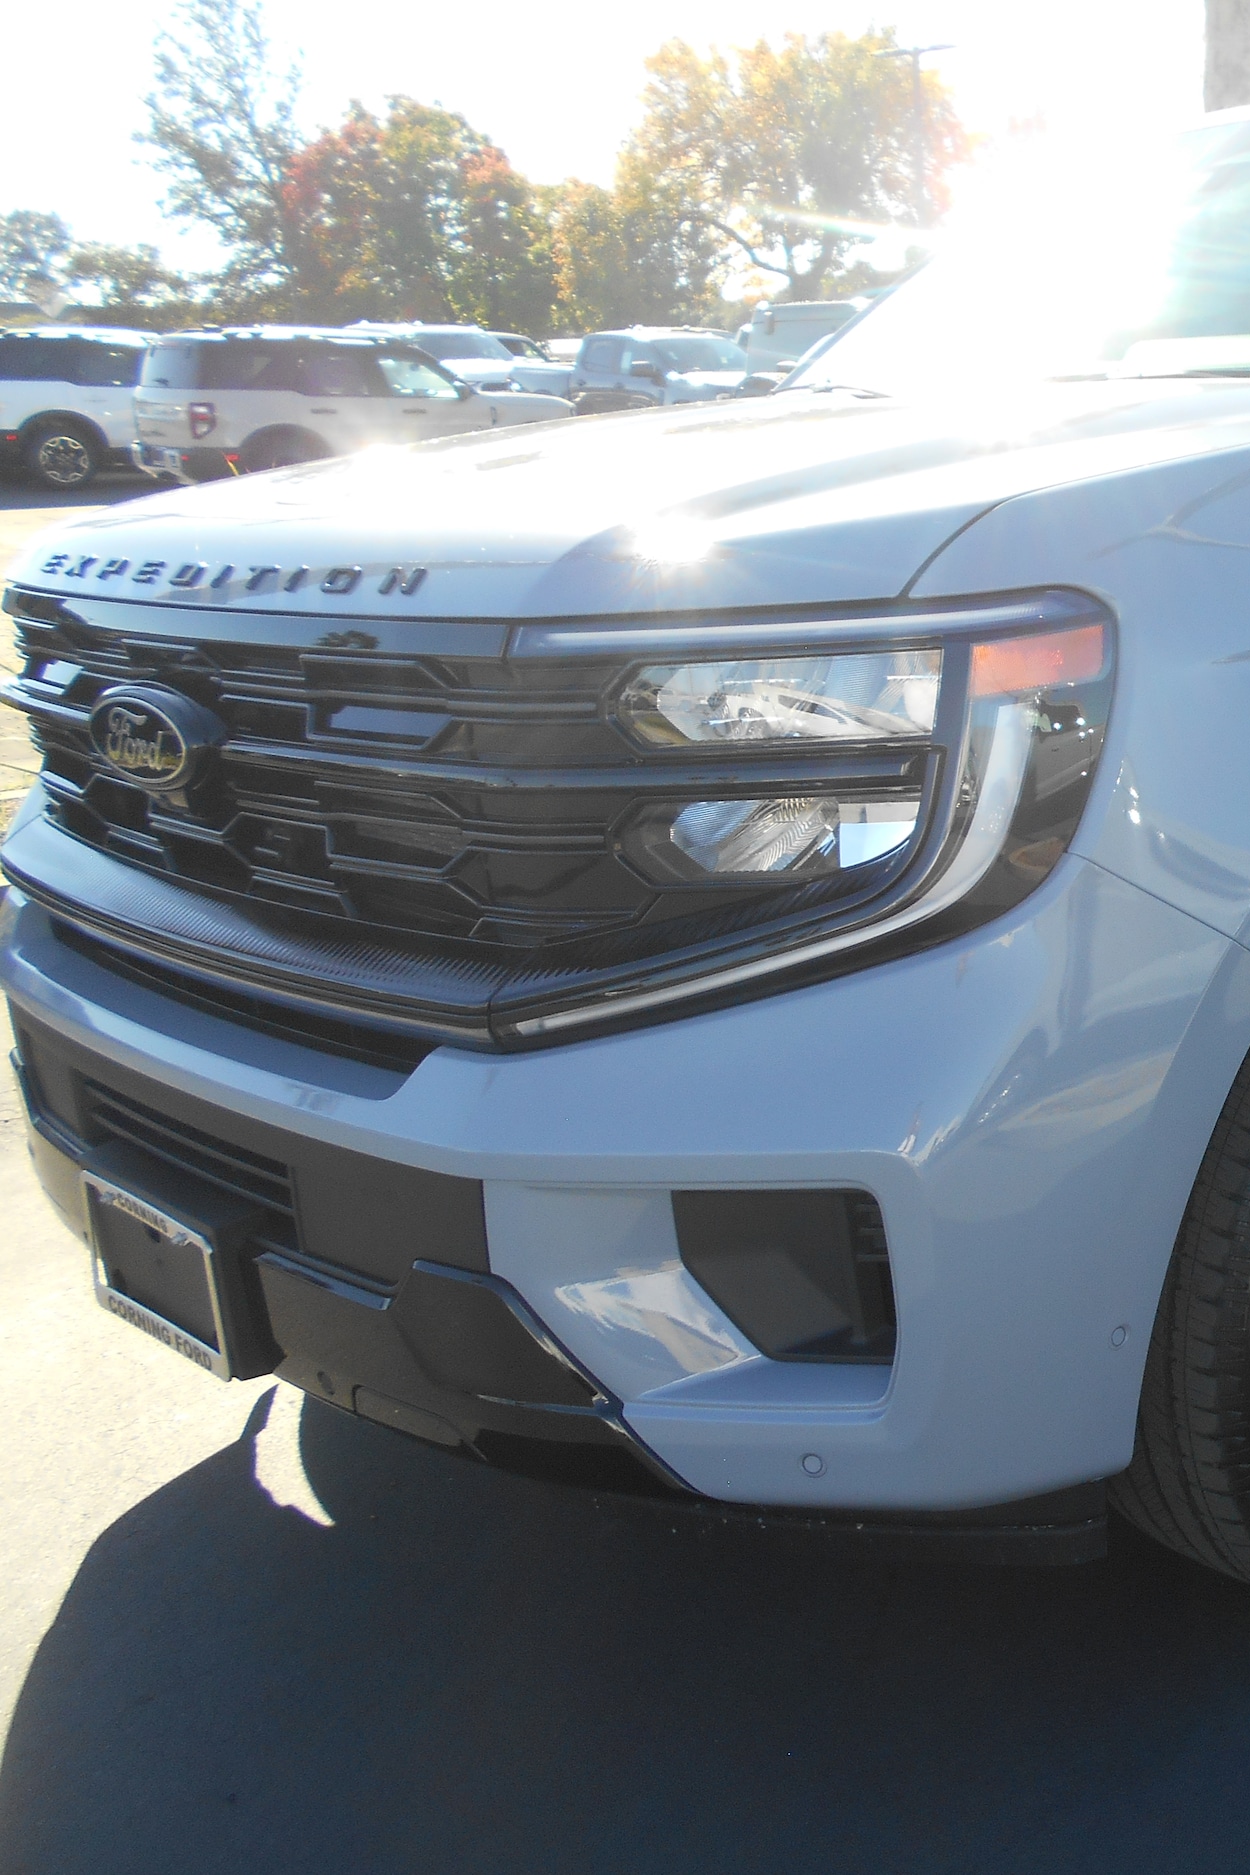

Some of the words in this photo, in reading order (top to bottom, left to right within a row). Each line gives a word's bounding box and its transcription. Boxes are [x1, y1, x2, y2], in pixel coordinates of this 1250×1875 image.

[41, 553, 429, 595] EXPEDITION
[106, 706, 165, 770] Ford
[108, 1295, 171, 1344] CORNING
[174, 1334, 213, 1371] FORD
